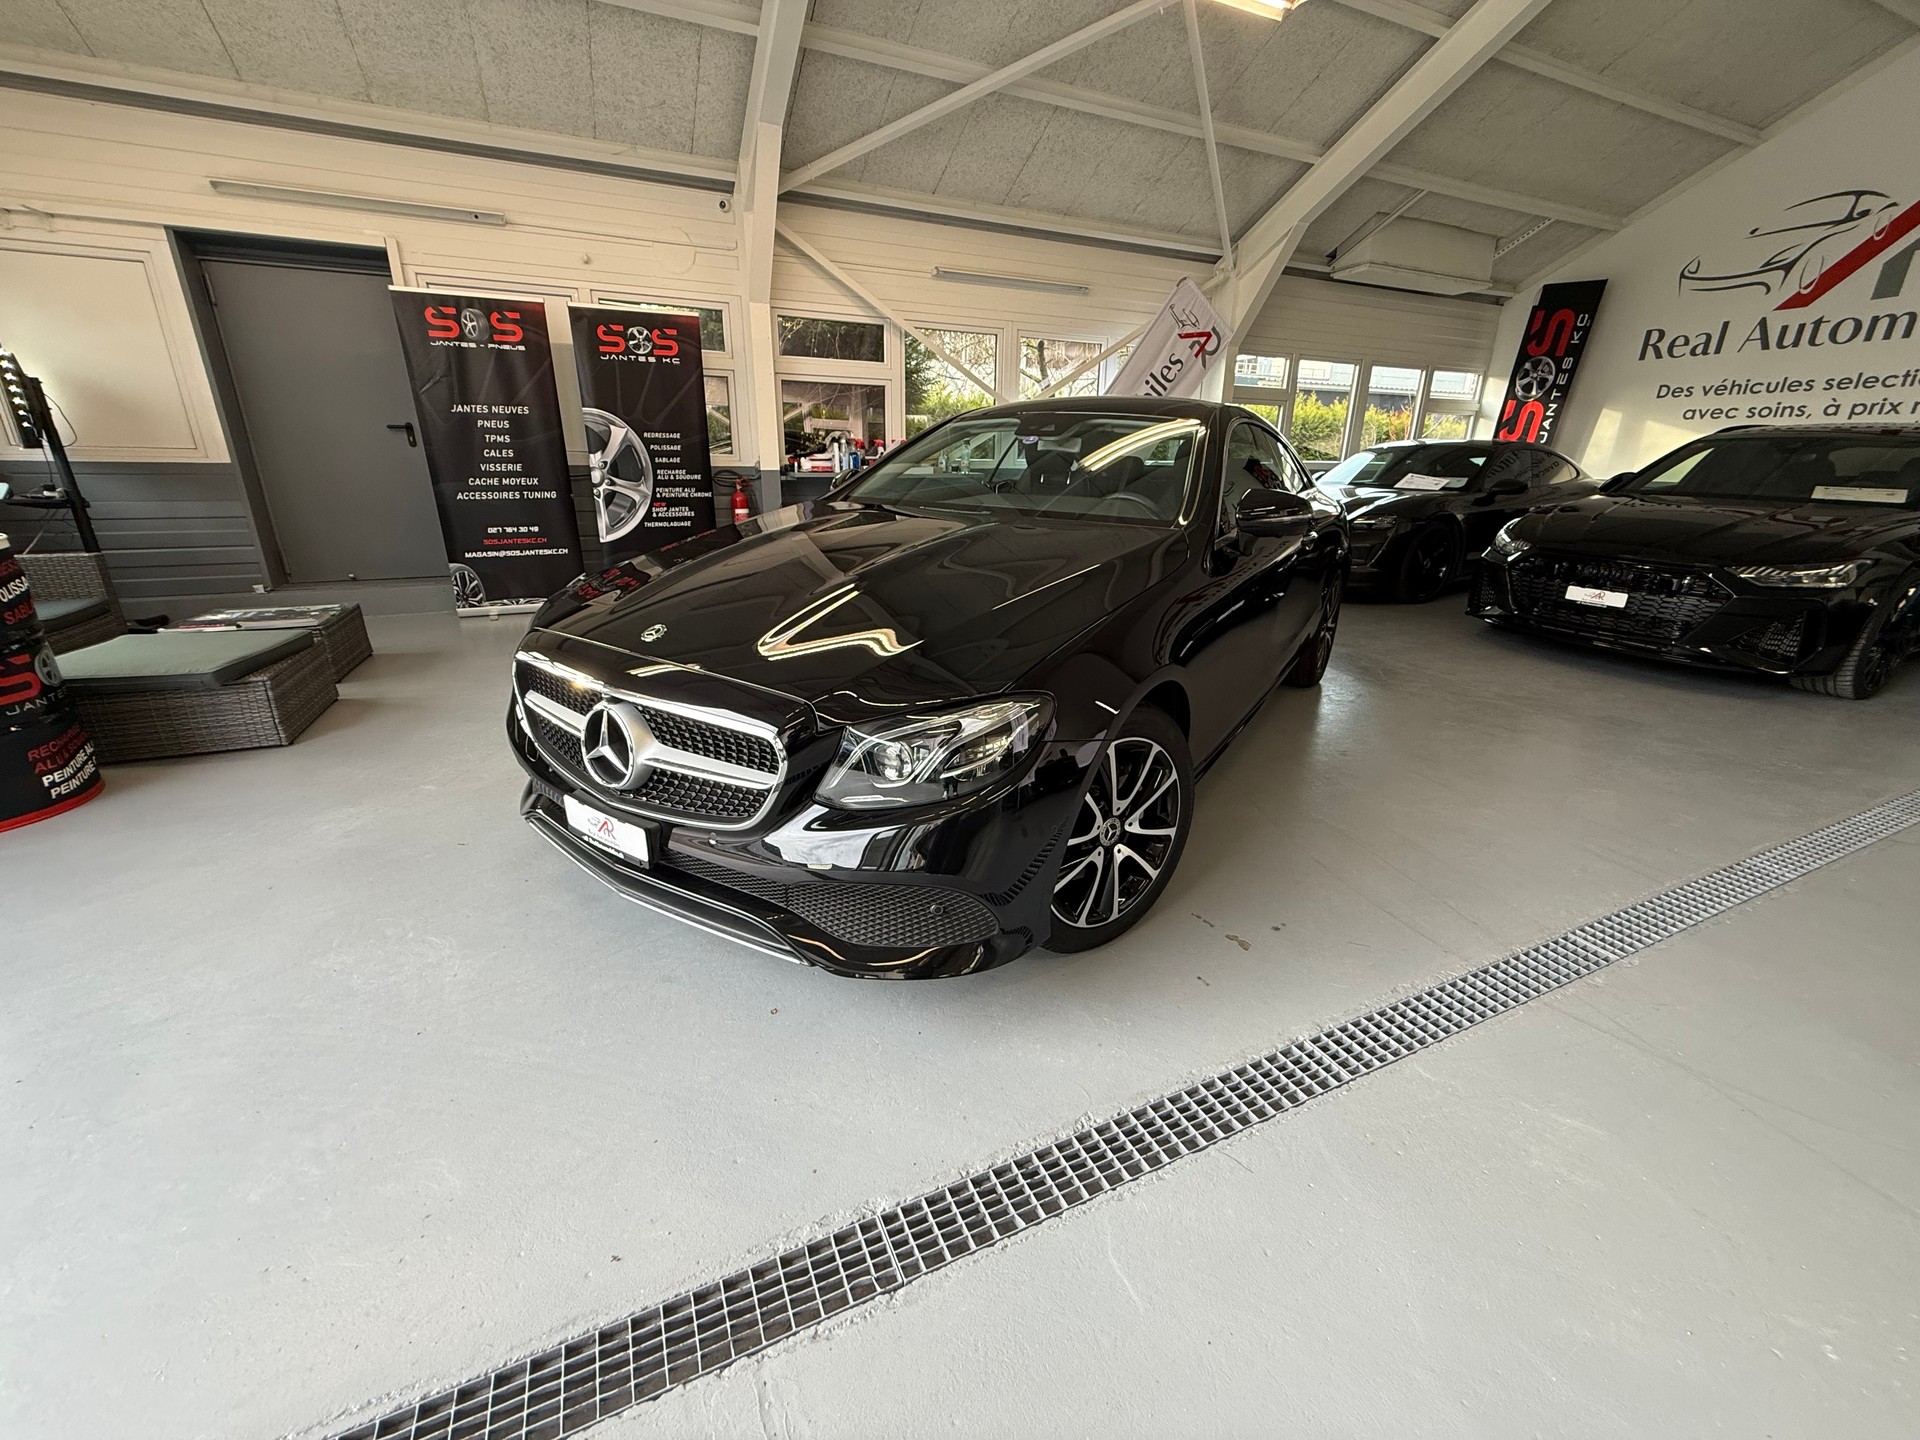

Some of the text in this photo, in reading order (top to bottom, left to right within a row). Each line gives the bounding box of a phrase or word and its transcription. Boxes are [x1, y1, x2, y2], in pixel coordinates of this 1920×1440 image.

[1638, 320, 1730, 361] Real
[430, 340, 477, 348] JANTES
[487, 343, 526, 351] PNEUS
[600, 354, 656, 363] JANTES
[1540, 313, 1589, 444] JANTES KC
[1656, 383, 1694, 399] Des
[1702, 376, 1815, 397] véhicules
[451, 404, 529, 415] JANTES NEUVES
[1682, 406, 1739, 420] avec
[1746, 401, 1812, 419] soins,
[1823, 397, 1842, 416] à
[1847, 397, 1903, 420] prix
[477, 420, 510, 429] PNEUS
[485, 434, 511, 443] TPMS
[483, 449, 514, 458] CALES
[480, 463, 523, 472] VISSERIE
[468, 477, 539, 486] CACHE MOYEUX
[456, 491, 557, 500] ACCESSOIRES TUNING
[487, 526, 502, 534] 027
[483, 537, 547, 545] SOSJANTESKC.CH
[42, 749, 88, 788] PEINTURE
[50, 760, 96, 799] PEINTURE
